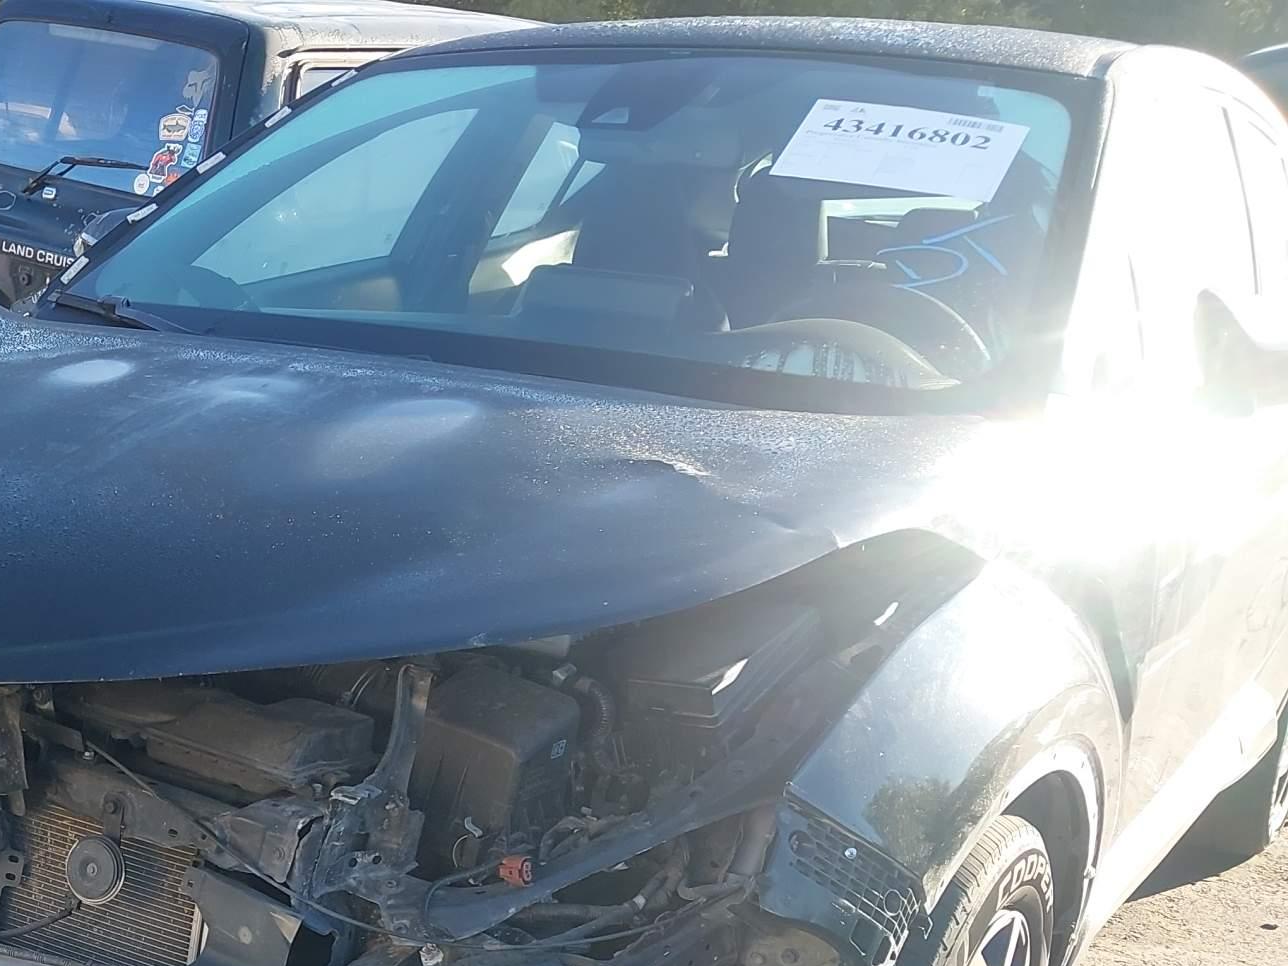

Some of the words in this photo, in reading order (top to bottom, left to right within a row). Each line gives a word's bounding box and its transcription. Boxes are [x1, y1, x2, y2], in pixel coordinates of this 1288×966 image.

[823, 118, 991, 149] 43416802
[2, 240, 33, 259] LAND
[995, 853, 1053, 913] COOPER
